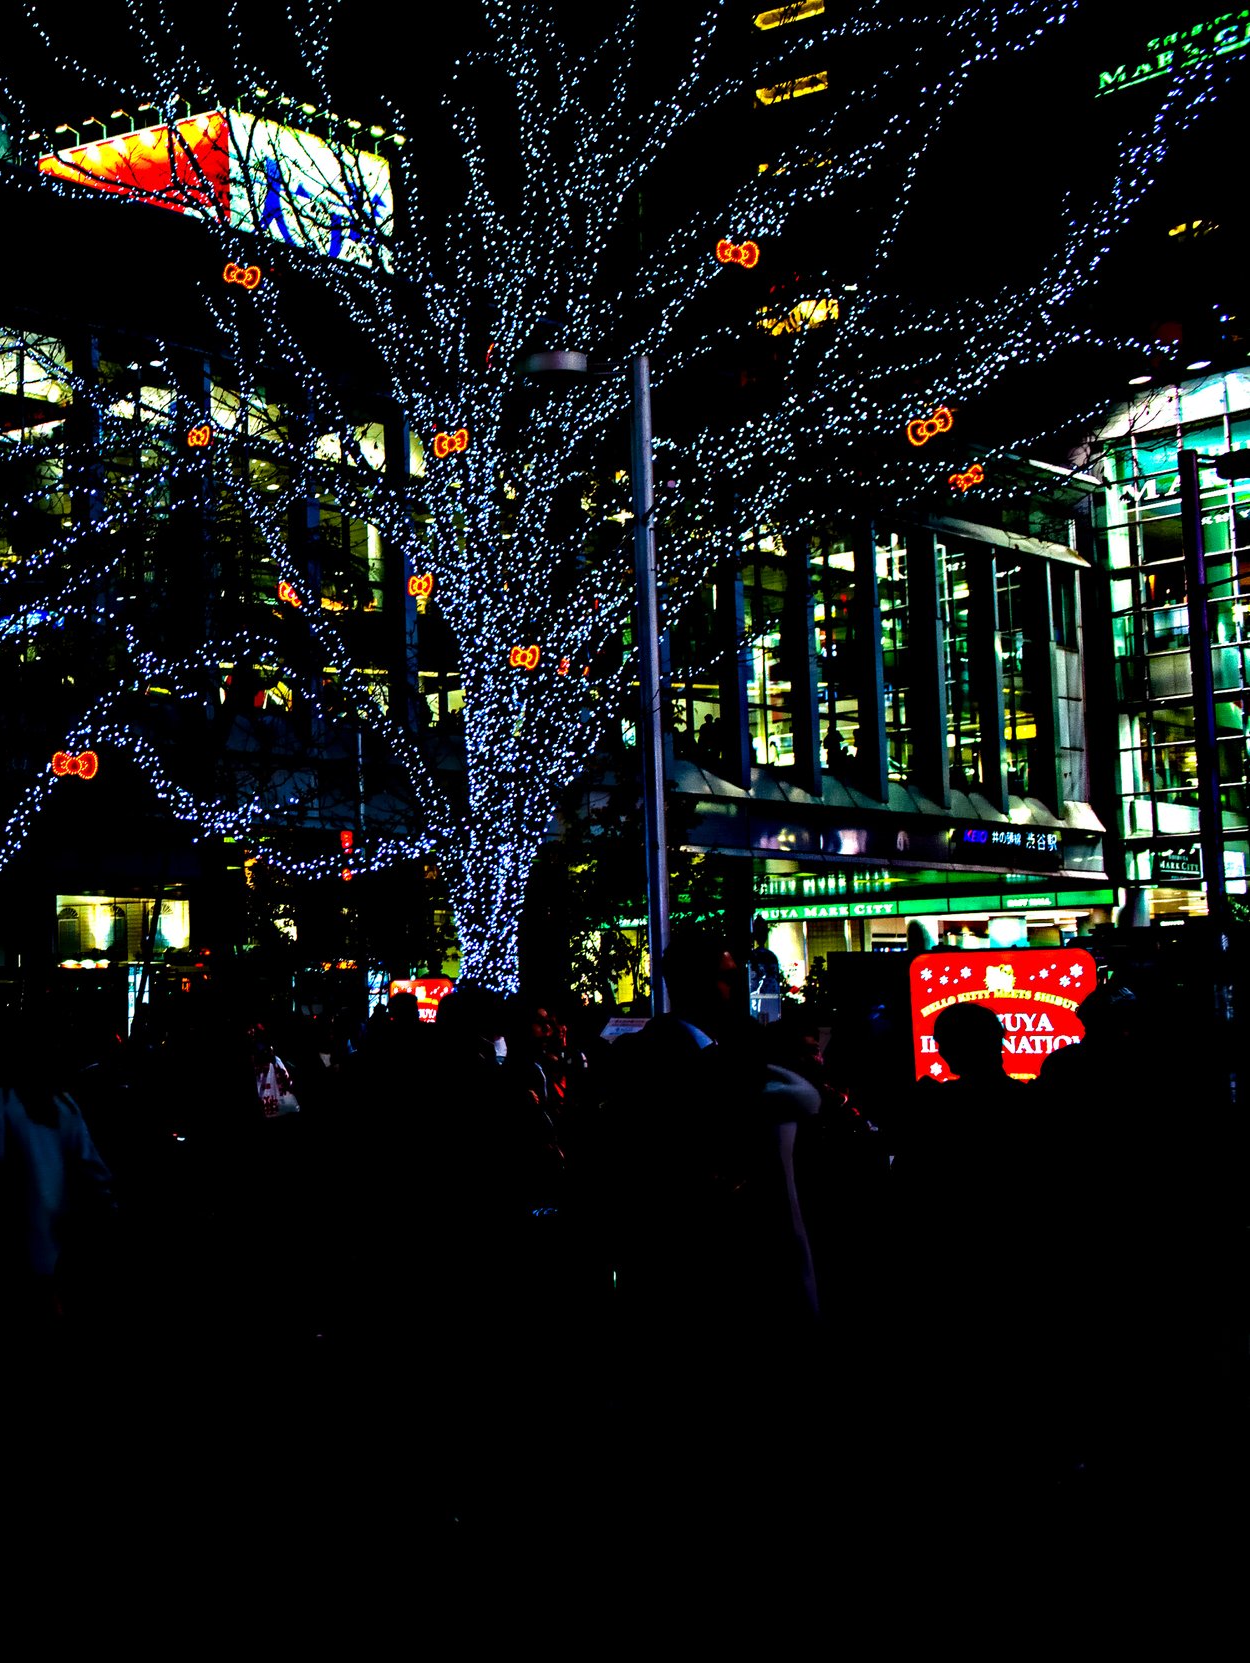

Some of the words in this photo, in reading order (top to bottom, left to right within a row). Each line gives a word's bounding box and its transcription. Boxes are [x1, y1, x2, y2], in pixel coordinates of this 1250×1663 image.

[1025, 831, 1058, 852] 渋谷駅
[803, 907, 850, 918] MARK
[853, 903, 894, 915] CITY
[920, 996, 957, 1018] HELLO
[957, 989, 991, 1003] KITTY
[1033, 991, 1080, 1013] SHIBUY
